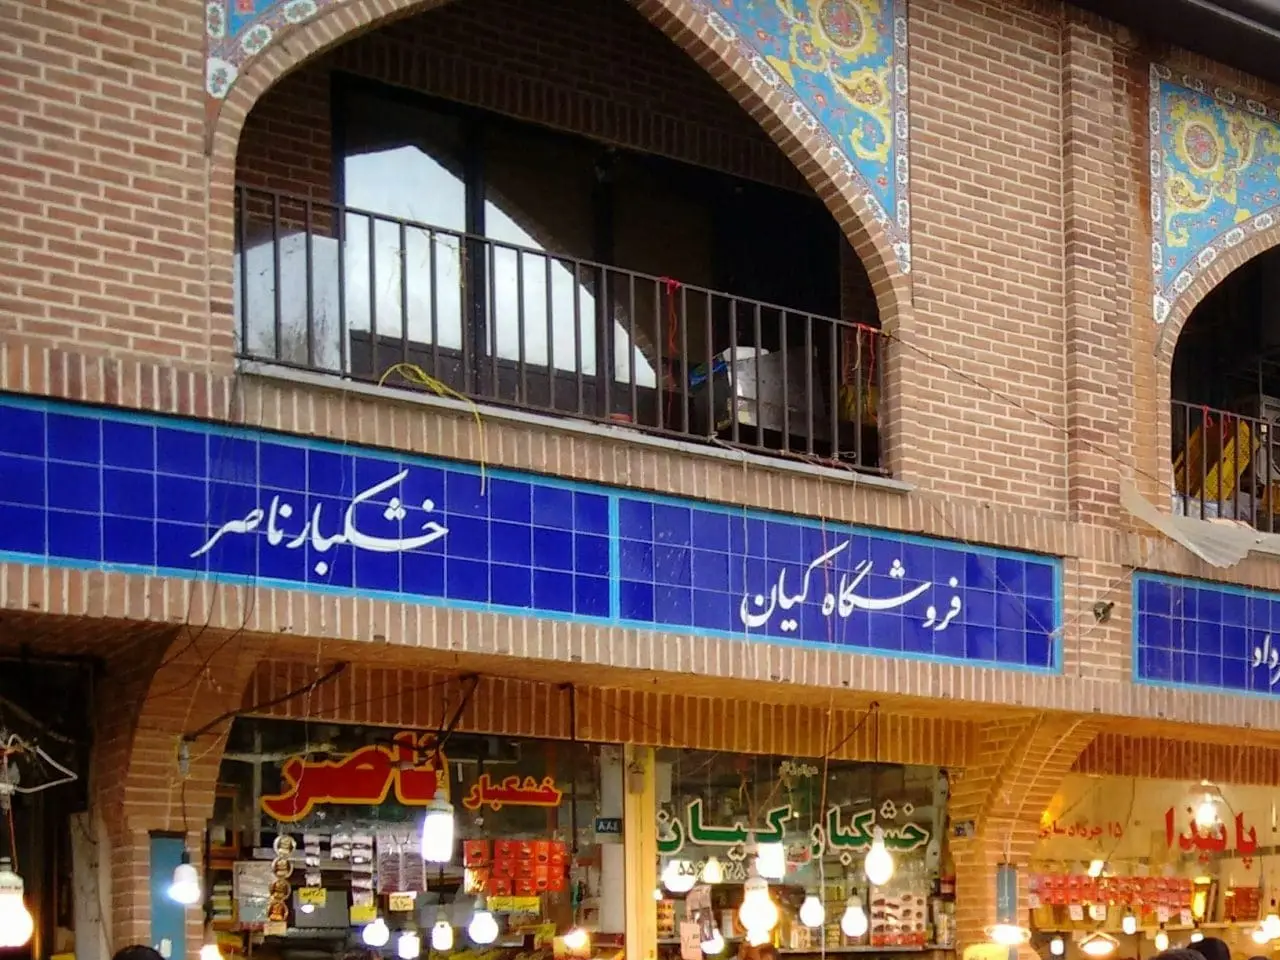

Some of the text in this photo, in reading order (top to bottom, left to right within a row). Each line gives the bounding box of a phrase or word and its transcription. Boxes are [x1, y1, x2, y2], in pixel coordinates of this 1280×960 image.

[190, 468, 450, 575] خشکبار ناصر
[740, 540, 962, 631] فروشگاه کیان
[261, 731, 563, 822] خشکبار ناصر
[656, 799, 791, 861] کیان
